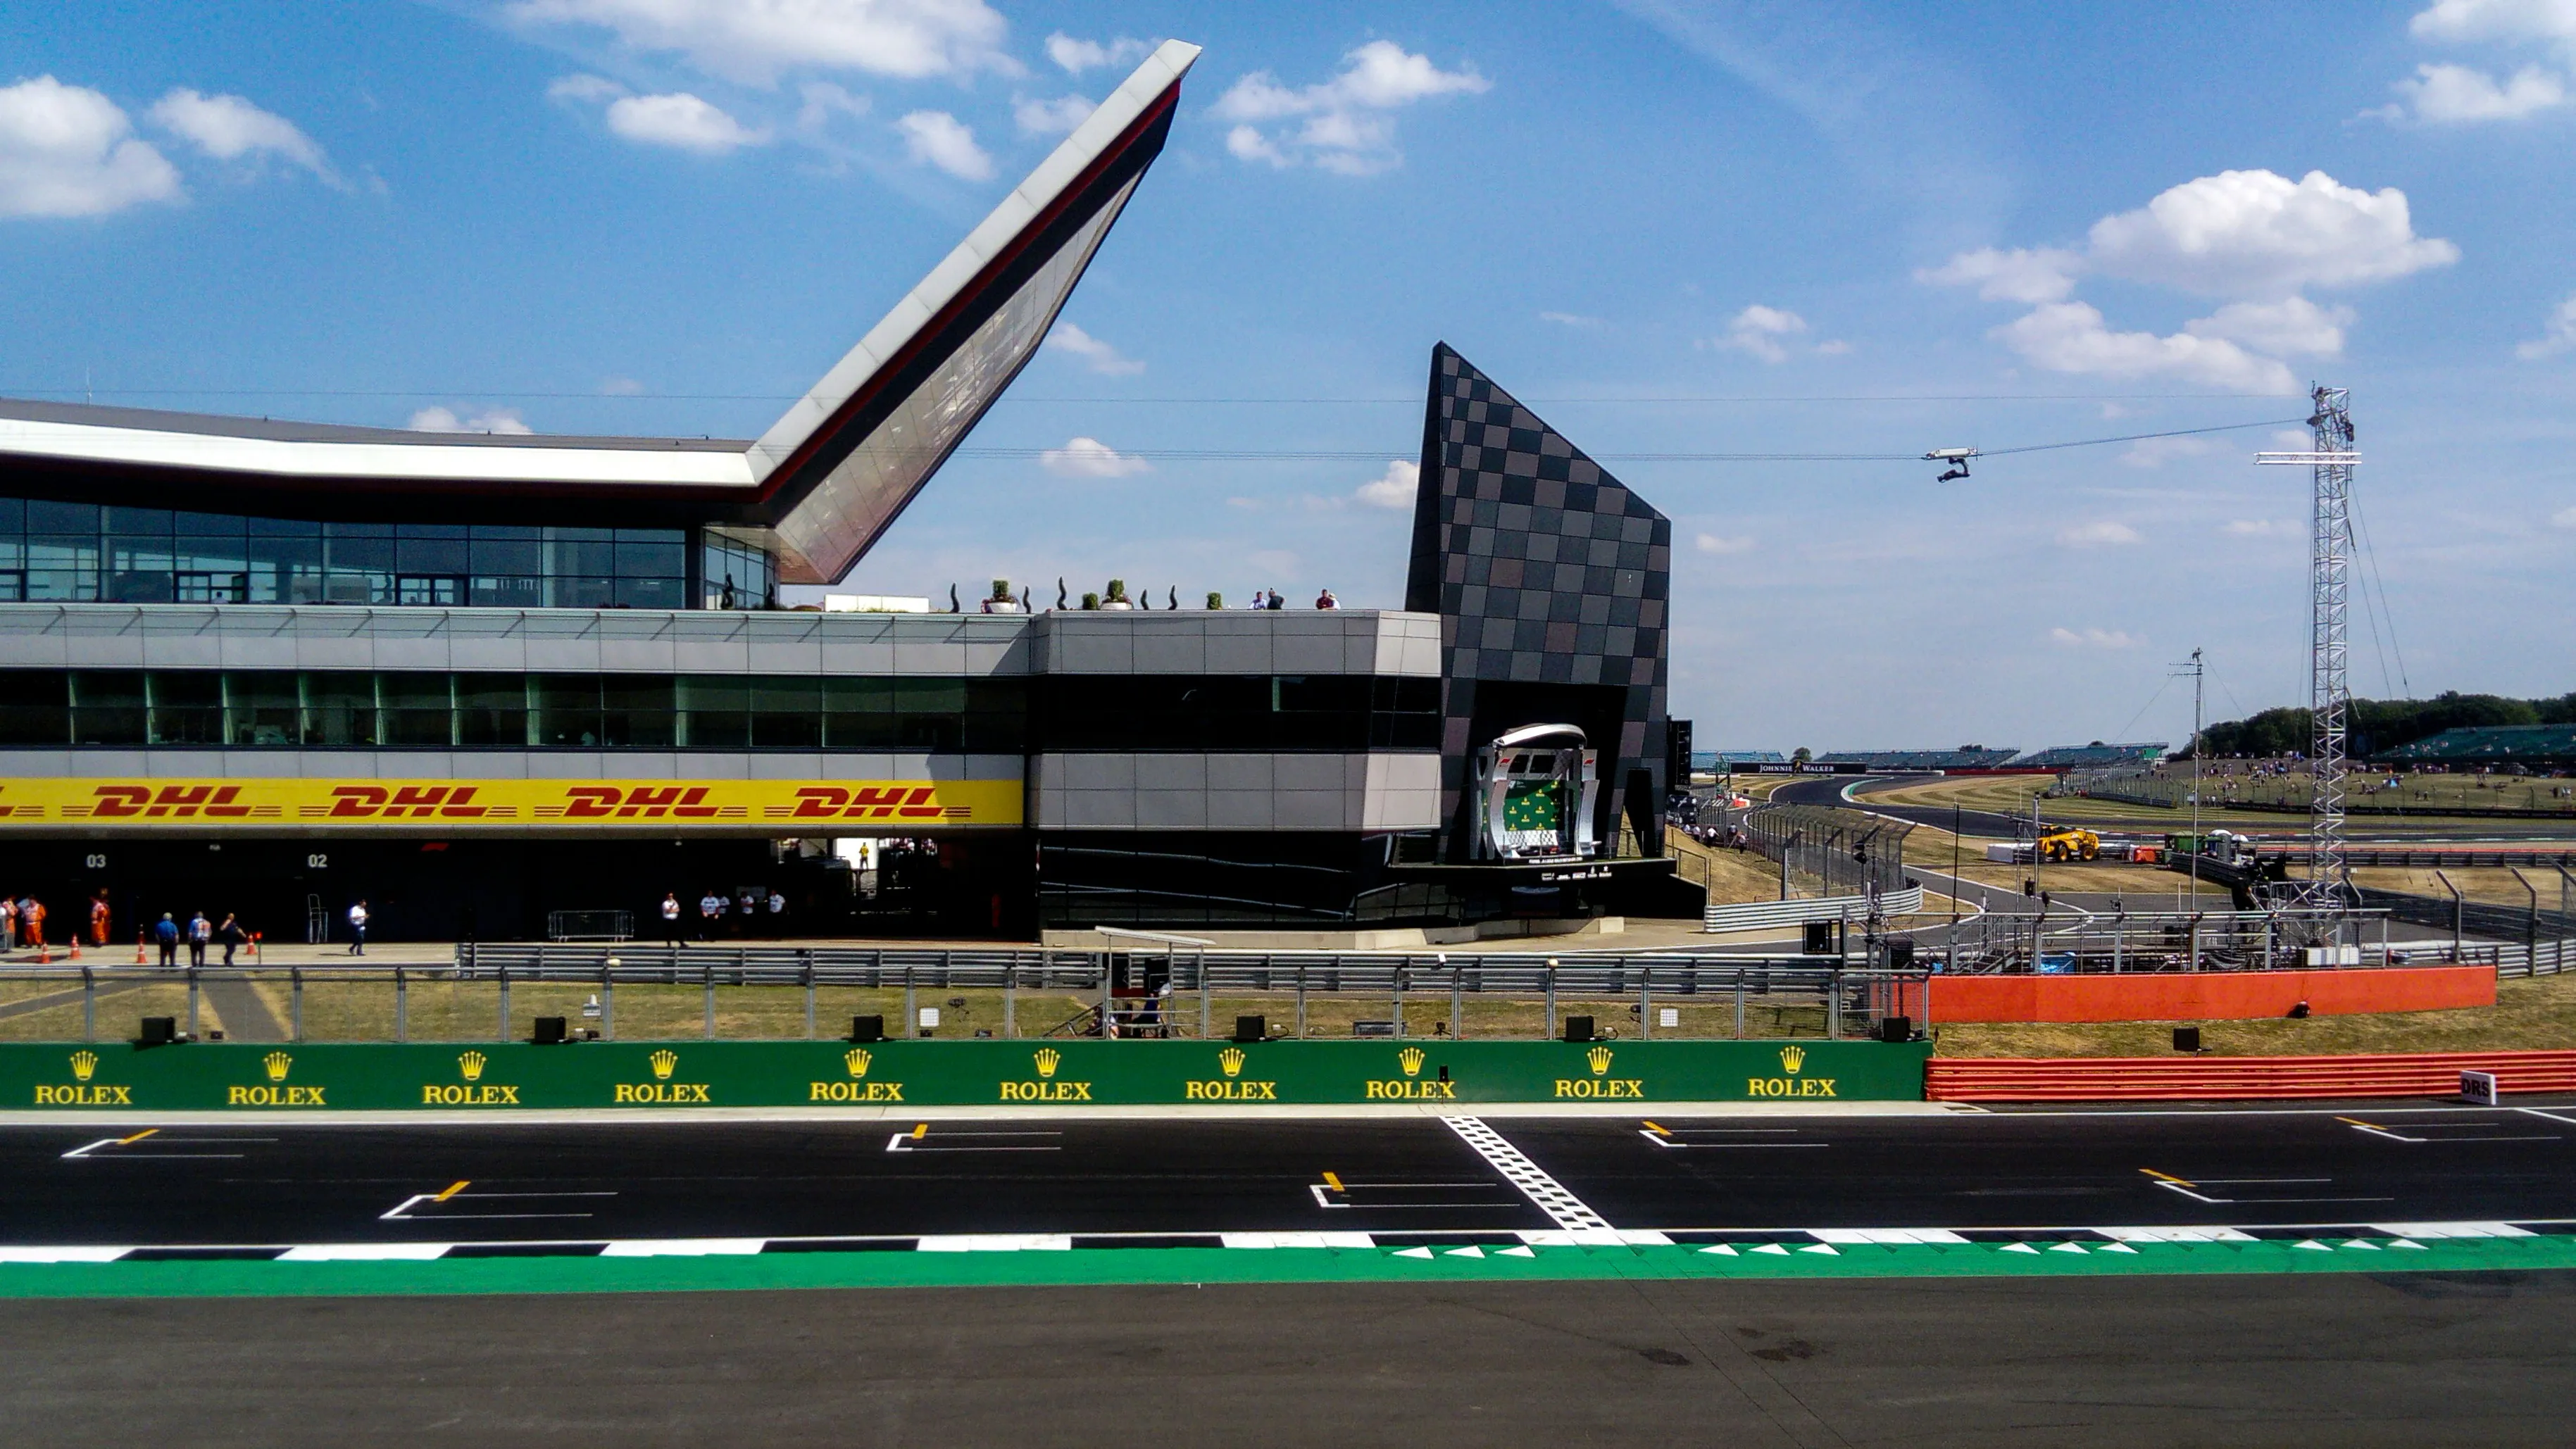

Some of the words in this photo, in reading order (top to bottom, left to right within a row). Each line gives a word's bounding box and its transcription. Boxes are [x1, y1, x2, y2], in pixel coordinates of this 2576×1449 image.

[1759, 764, 1793, 773] JOHNNIE
[92, 786, 251, 817] DHL
[330, 786, 488, 817] DHL
[564, 786, 719, 817] DHL
[794, 787, 944, 817] DHL
[87, 854, 106, 868] 03
[308, 854, 327, 868] 02
[35, 1085, 132, 1105] ROLEX
[228, 1086, 326, 1105] ROLEX
[423, 1085, 520, 1105] ROLEX
[614, 1084, 711, 1103] ROLEX
[810, 1081, 904, 1102] ROLEX
[1000, 1081, 1092, 1100] ROLEX
[1186, 1081, 1277, 1100] ROLEX
[1365, 1080, 1456, 1099] ROLEX
[1554, 1079, 1644, 1098] ROLEX
[1748, 1078, 1837, 1097] ROLEX
[2461, 1077, 2490, 1097] DRS
